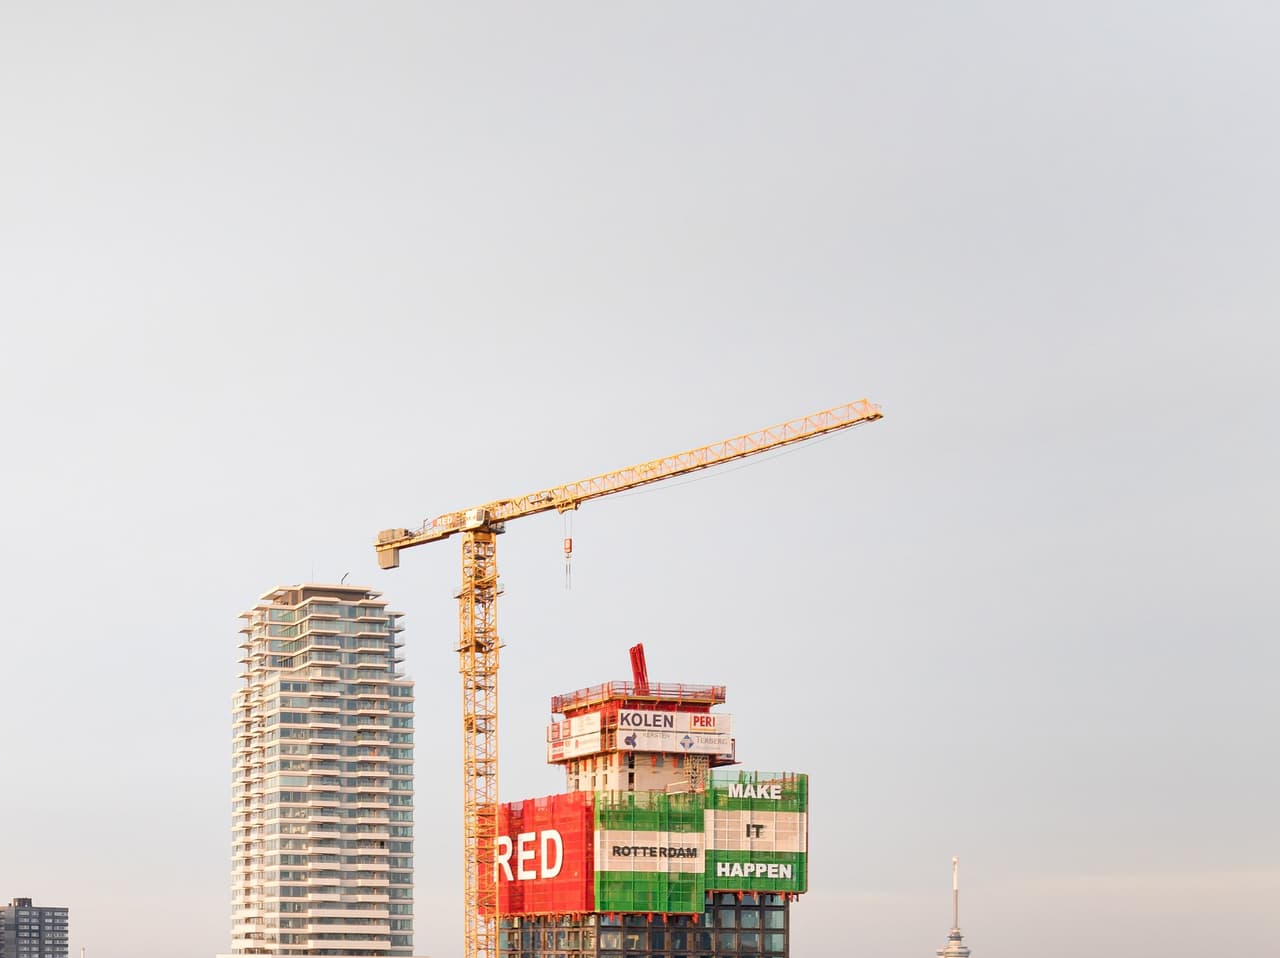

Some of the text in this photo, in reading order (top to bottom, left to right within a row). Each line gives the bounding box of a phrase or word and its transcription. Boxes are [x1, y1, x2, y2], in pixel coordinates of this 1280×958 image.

[620, 713, 674, 728] KOLEN
[693, 715, 715, 727] PERI
[728, 784, 782, 800] MAKE
[746, 823, 763, 838] IT
[494, 829, 564, 882] RED
[612, 845, 697, 858] ROTTERDAM
[716, 862, 792, 879] HAPPEN
